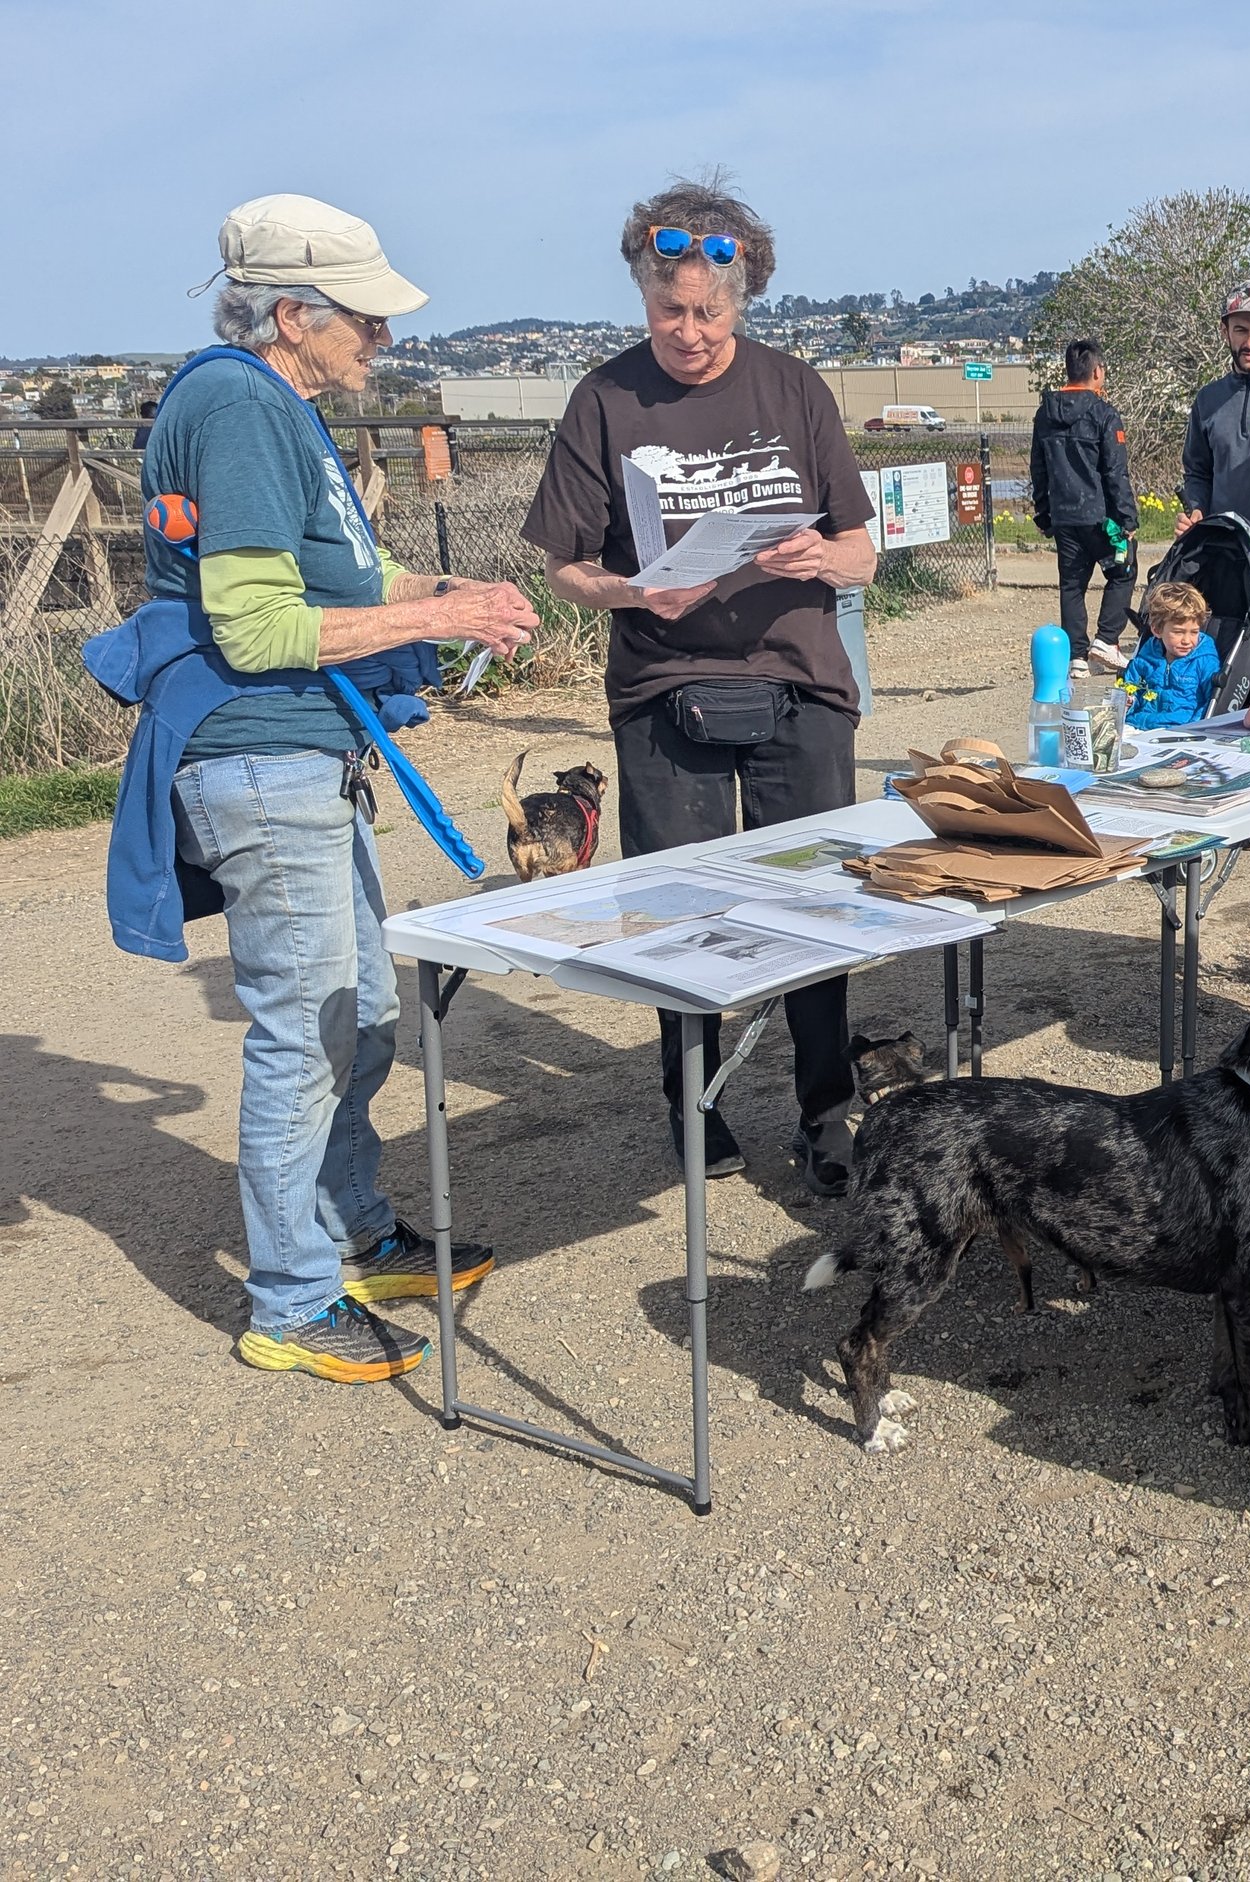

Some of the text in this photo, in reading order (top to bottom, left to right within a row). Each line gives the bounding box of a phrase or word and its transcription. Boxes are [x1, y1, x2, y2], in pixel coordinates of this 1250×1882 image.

[679, 492, 720, 510] Isabel
[724, 487, 749, 506] Dog
[753, 482, 802, 498] Owners
